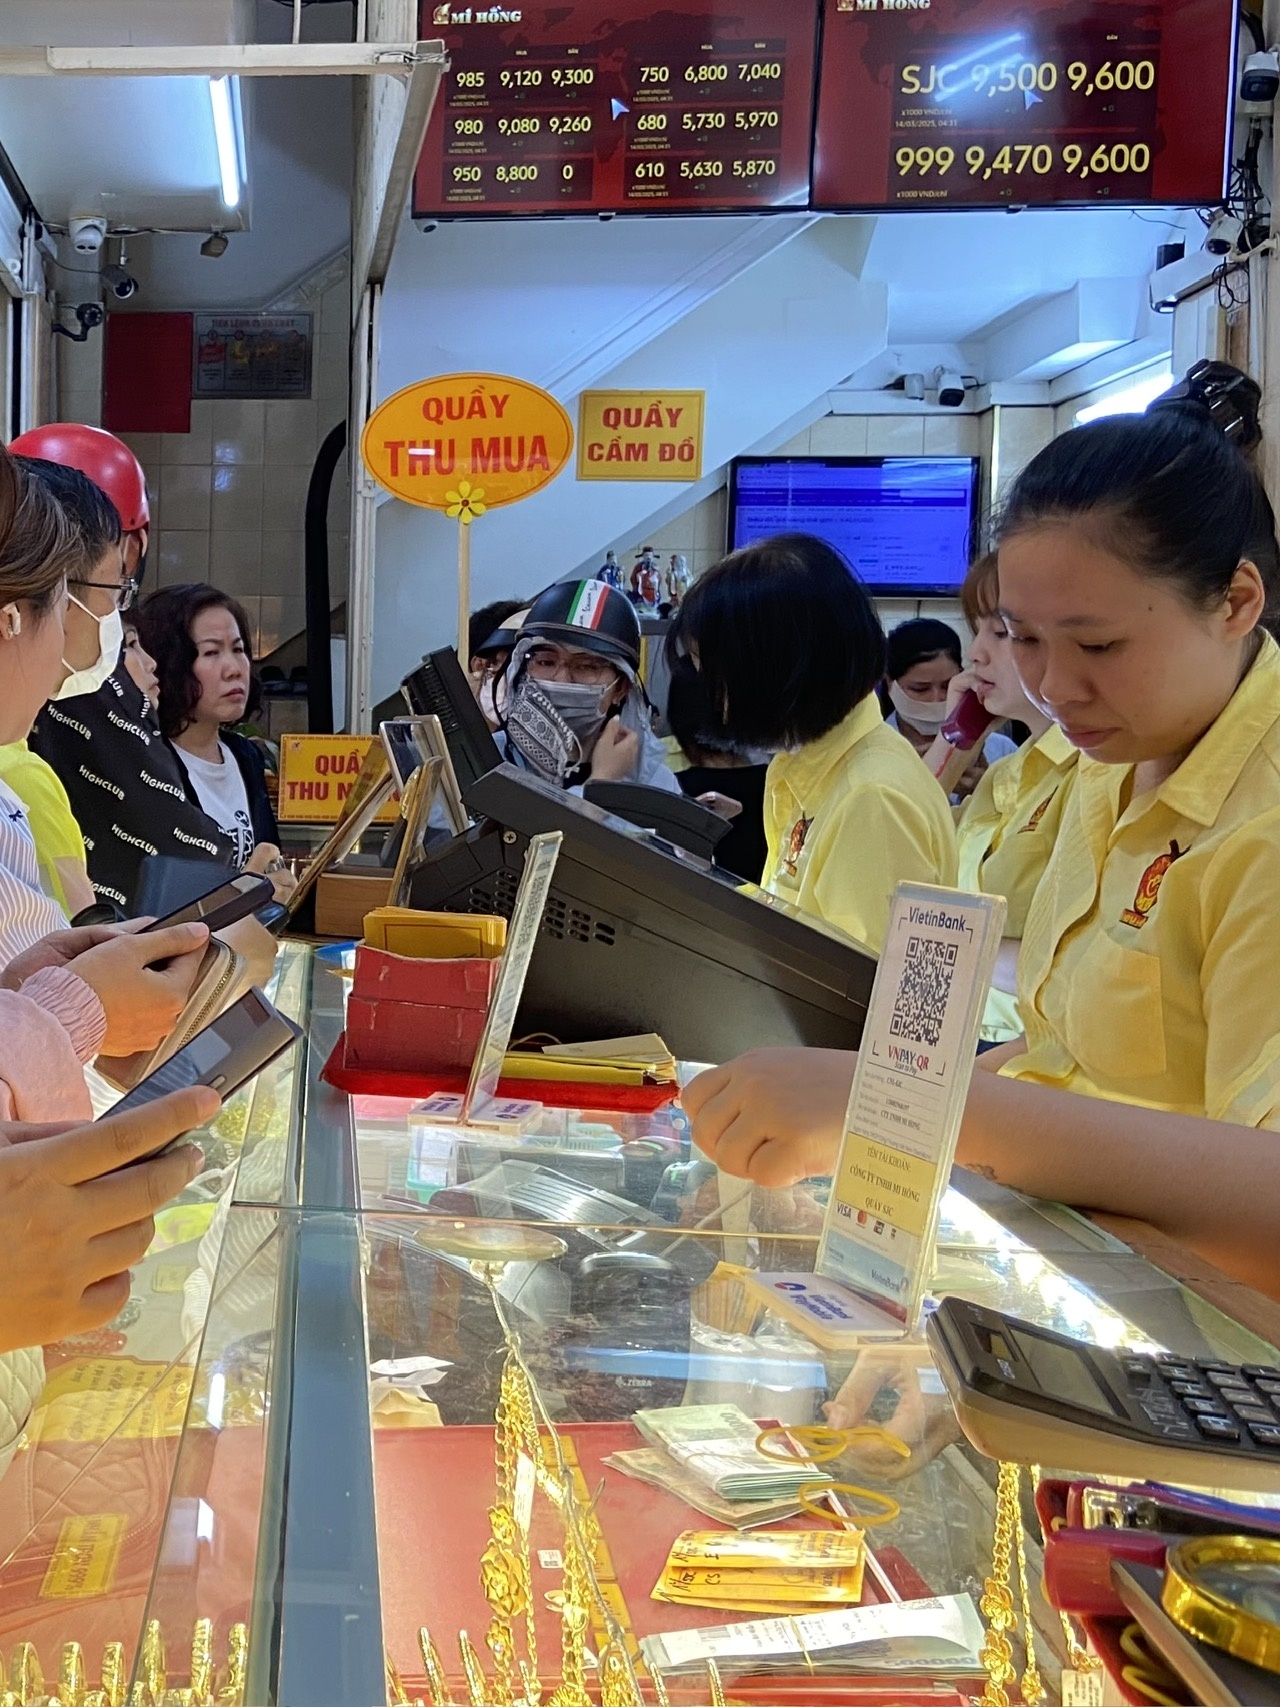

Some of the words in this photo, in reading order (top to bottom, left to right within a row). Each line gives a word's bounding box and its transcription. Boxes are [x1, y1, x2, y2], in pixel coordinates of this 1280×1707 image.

[456, 72, 485, 88] 985
[500, 70, 542, 89] 9,120
[551, 68, 594, 88] 9,300
[640, 66, 669, 83] 750
[684, 65, 728, 84] 6,800
[738, 63, 781, 82] 7,040
[901, 64, 958, 94] SJC
[971, 62, 1057, 98] 9,500
[1067, 60, 1155, 96] 9,600
[455, 119, 483, 135] 980
[498, 118, 540, 136] 9,080
[549, 116, 592, 135] 9,260
[637, 114, 667, 130] 680
[682, 112, 725, 132] 5,730
[735, 111, 778, 130] 5,970
[452, 166, 481, 182] 950
[495, 165, 538, 183] 8,800
[562, 164, 573, 180] 0
[635, 162, 665, 178] 610
[680, 161, 723, 179] 5,630
[732, 159, 776, 178] 5,870
[895, 145, 955, 176] 999
[965, 144, 1053, 180] 9,470
[1062, 143, 1150, 179] 9,600
[421, 385, 510, 426] QUẦY
[602, 400, 684, 428] QUẦY
[383, 439, 456, 477] THU
[470, 435, 551, 474] MUA
[587, 435, 651, 463] CẦM
[658, 436, 695, 463] ĐỒ
[47, 704, 92, 740] HIGHCLUB
[107, 710, 151, 746] HIGHCLUB
[314, 748, 368, 777] QUẦ
[78, 764, 125, 801] HIGHCLUB
[139, 769, 186, 803] HIGHCLUB
[287, 781, 329, 801] THU
[111, 823, 159, 857] HIGHCLUB
[173, 827, 218, 856] HIGHCLUB
[90, 881, 127, 906] GHCLUB
[909, 905, 967, 933] VietinBank
[837, 1202, 851, 1219] VISA
